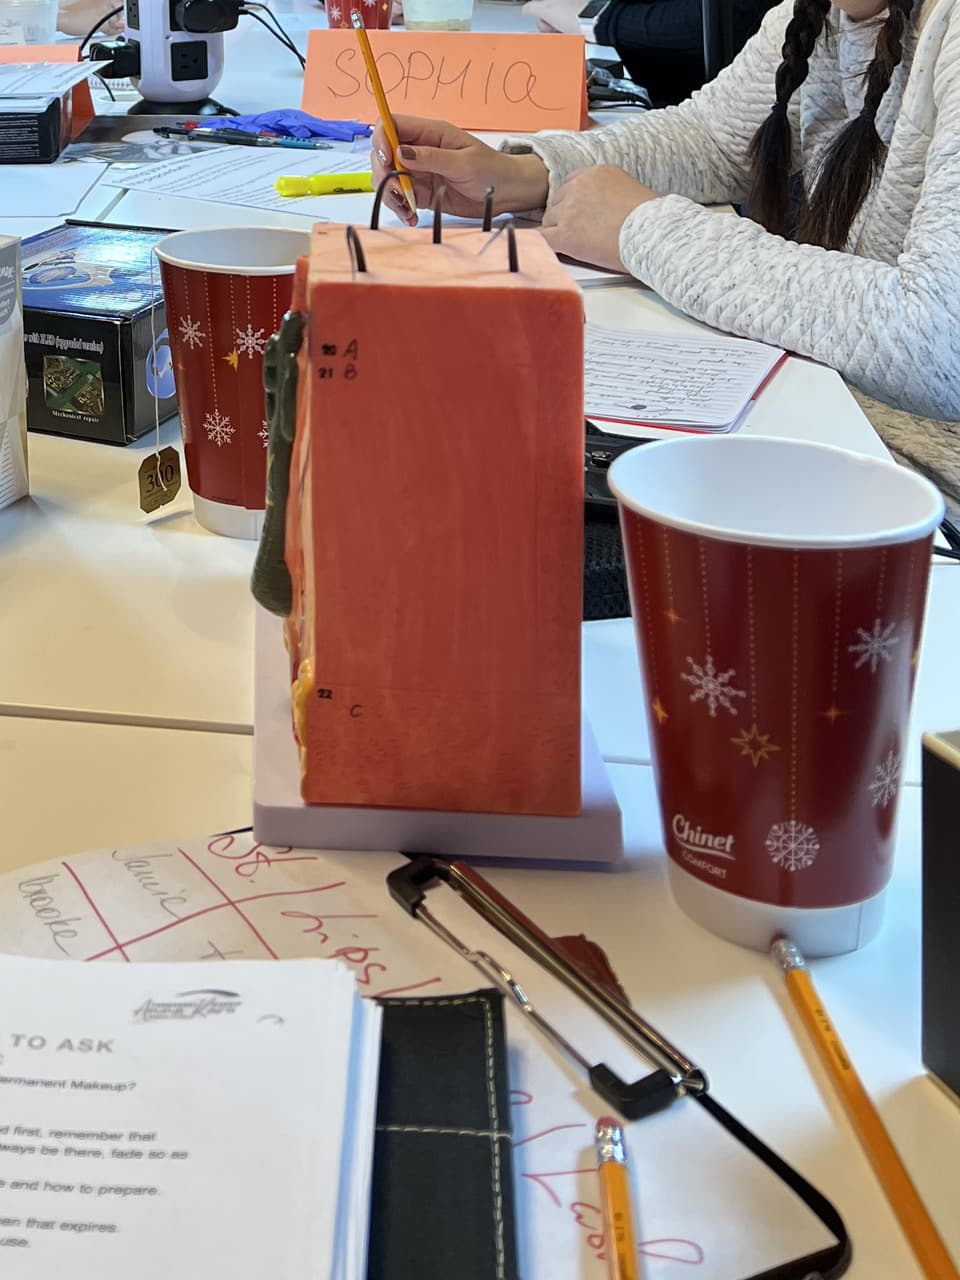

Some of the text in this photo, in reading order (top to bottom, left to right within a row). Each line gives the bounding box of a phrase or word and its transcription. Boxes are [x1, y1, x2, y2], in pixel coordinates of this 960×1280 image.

[672, 814, 736, 853] Chinet
[11, 1033, 47, 1051] TO
[56, 1037, 116, 1054] ASK
[47, 1128, 124, 1142] remember
[127, 1130, 159, 1143] that
[109, 1147, 143, 1160] fade
